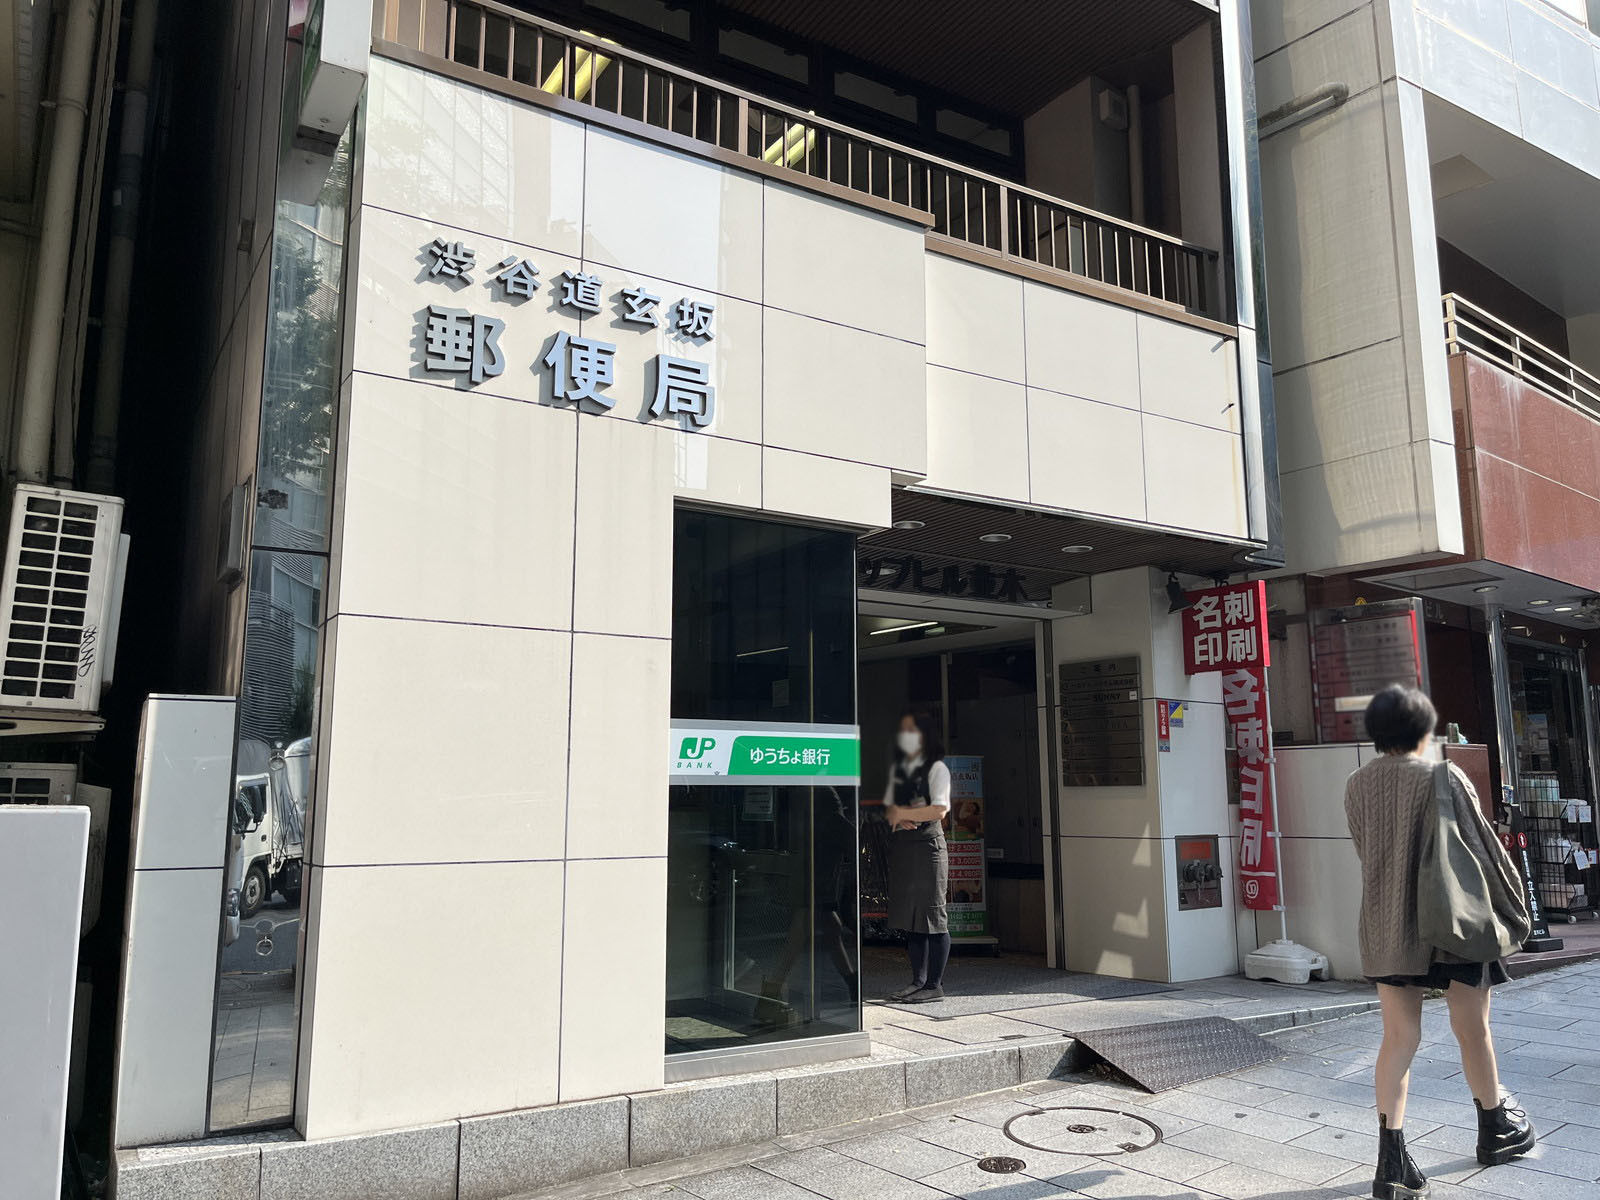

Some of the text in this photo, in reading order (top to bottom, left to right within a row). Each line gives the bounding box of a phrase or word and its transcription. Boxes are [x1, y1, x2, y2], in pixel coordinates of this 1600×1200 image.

[428, 236, 716, 342] 渋谷道玄坂
[425, 304, 716, 427] 郵便局
[1193, 588, 1255, 630] 名刺
[1193, 626, 1258, 666] 印刷
[676, 761, 713, 769] BANK
[679, 737, 717, 760] JP
[749, 747, 831, 765] ゆうちょ銀行
[1527, 880, 1540, 921] 立入禁止
